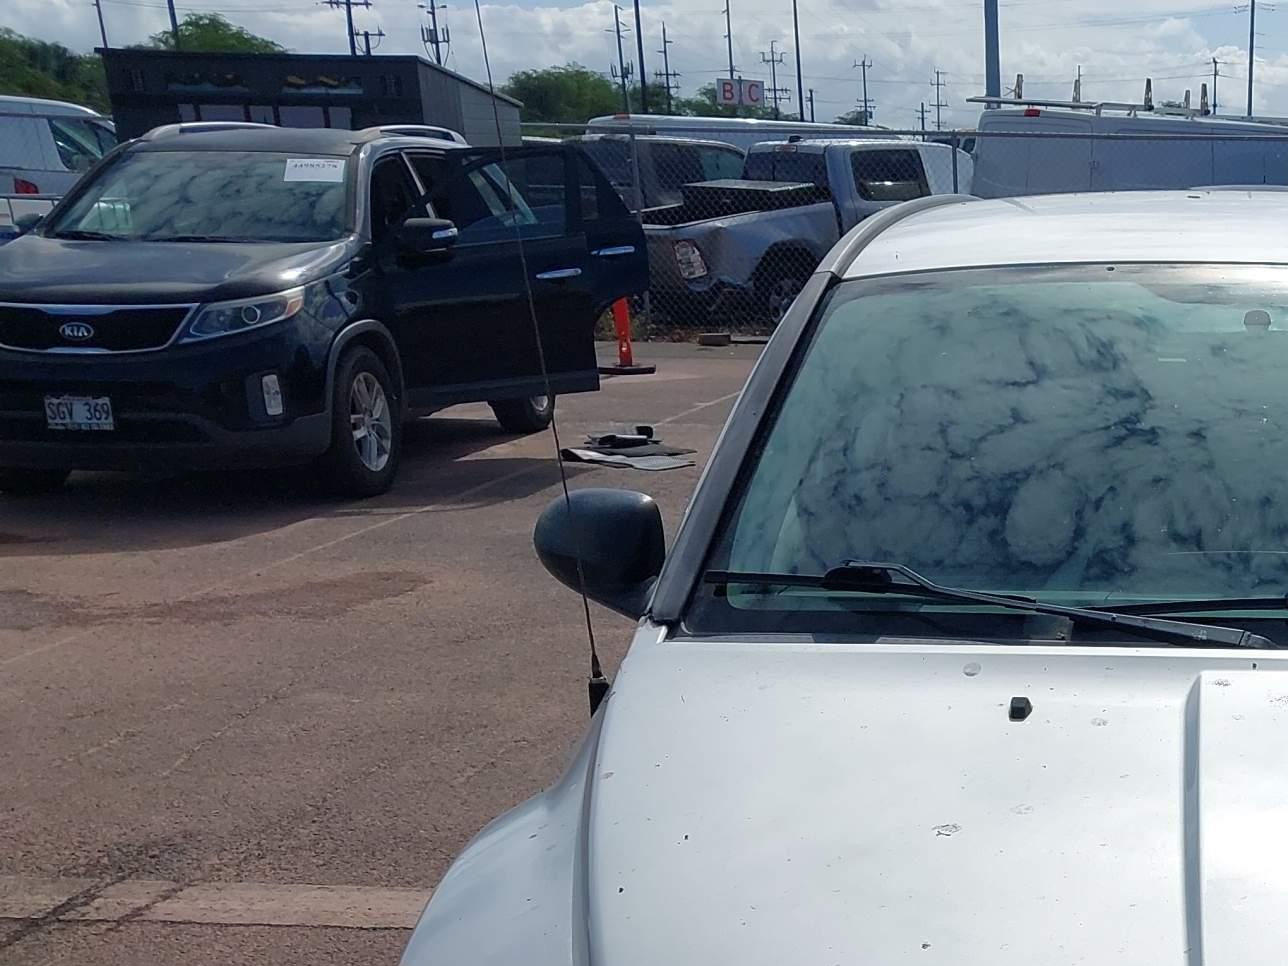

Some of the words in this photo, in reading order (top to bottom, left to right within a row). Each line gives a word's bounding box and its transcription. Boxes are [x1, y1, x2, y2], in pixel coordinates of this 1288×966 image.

[723, 82, 734, 100] B
[748, 83, 760, 102] C
[63, 326, 89, 337] KIA
[47, 402, 73, 421] SGV
[83, 402, 111, 421] 369
